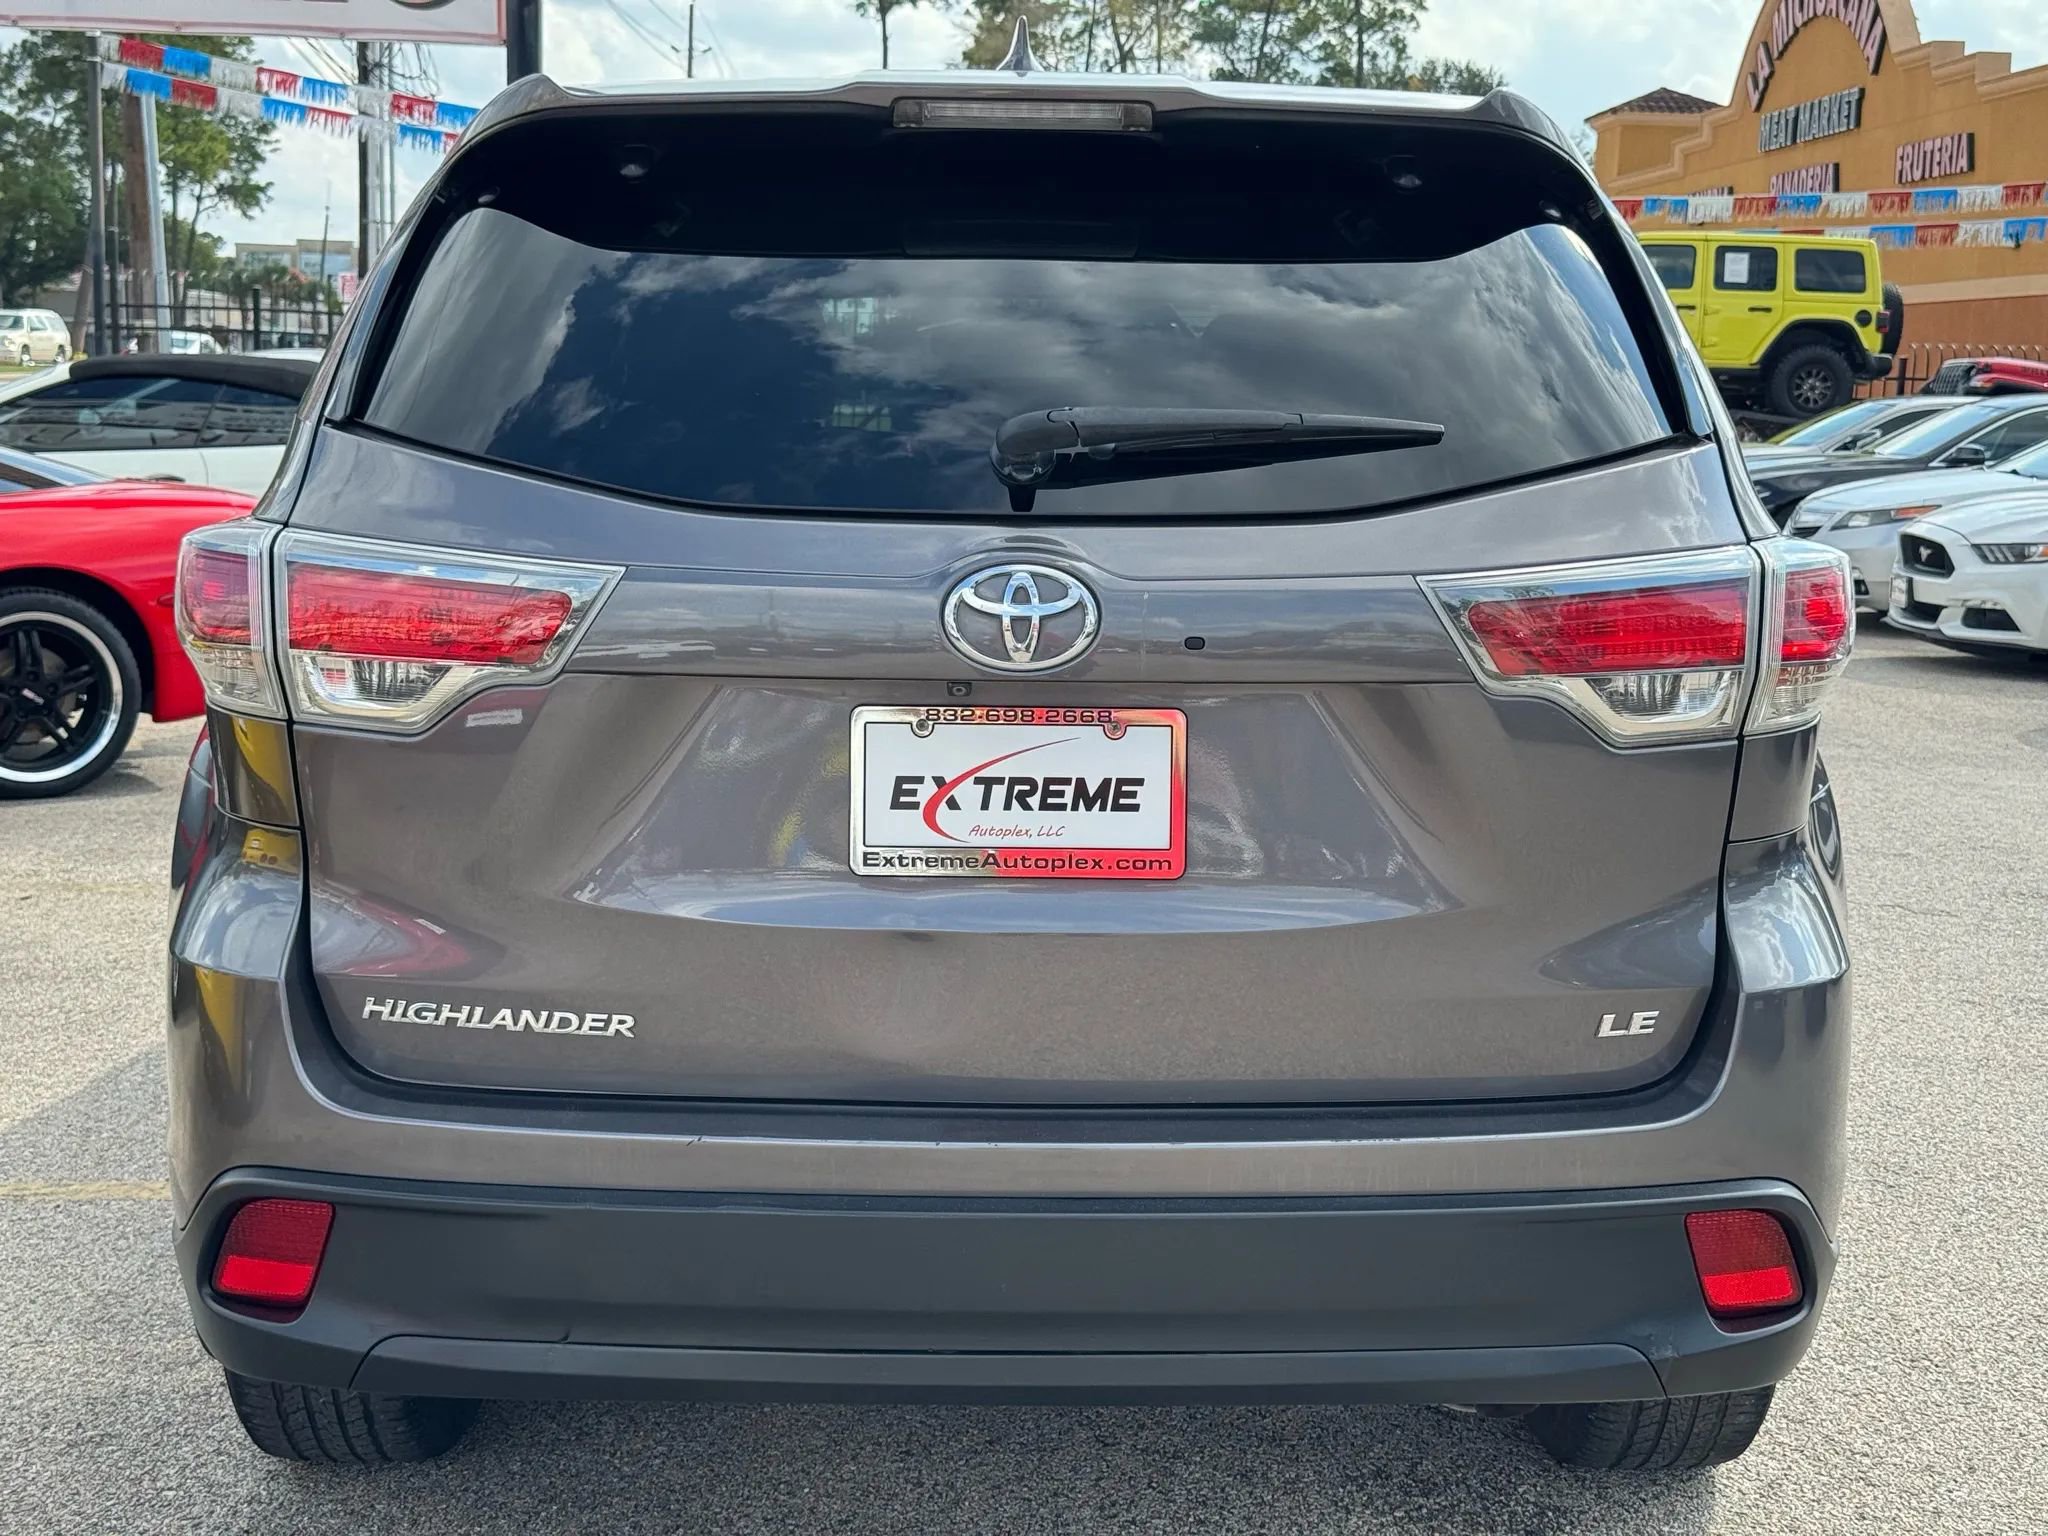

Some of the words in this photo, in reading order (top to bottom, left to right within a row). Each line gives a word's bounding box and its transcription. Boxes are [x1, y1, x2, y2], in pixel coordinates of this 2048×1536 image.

[1747, 41, 1773, 112] LA
[1758, 105, 1797, 152] MEAT
[1797, 86, 1862, 143] MARKET
[1895, 133, 1970, 184] FRUTERIA
[889, 775, 1145, 813] EXTREME
[968, 824, 1033, 840] Autoplex,
[1036, 825, 1066, 837] LLC
[862, 851, 1173, 874] ExtremeAutoplex.com
[362, 997, 635, 1038] HIGHLANDER
[1597, 1010, 1660, 1038] LE
